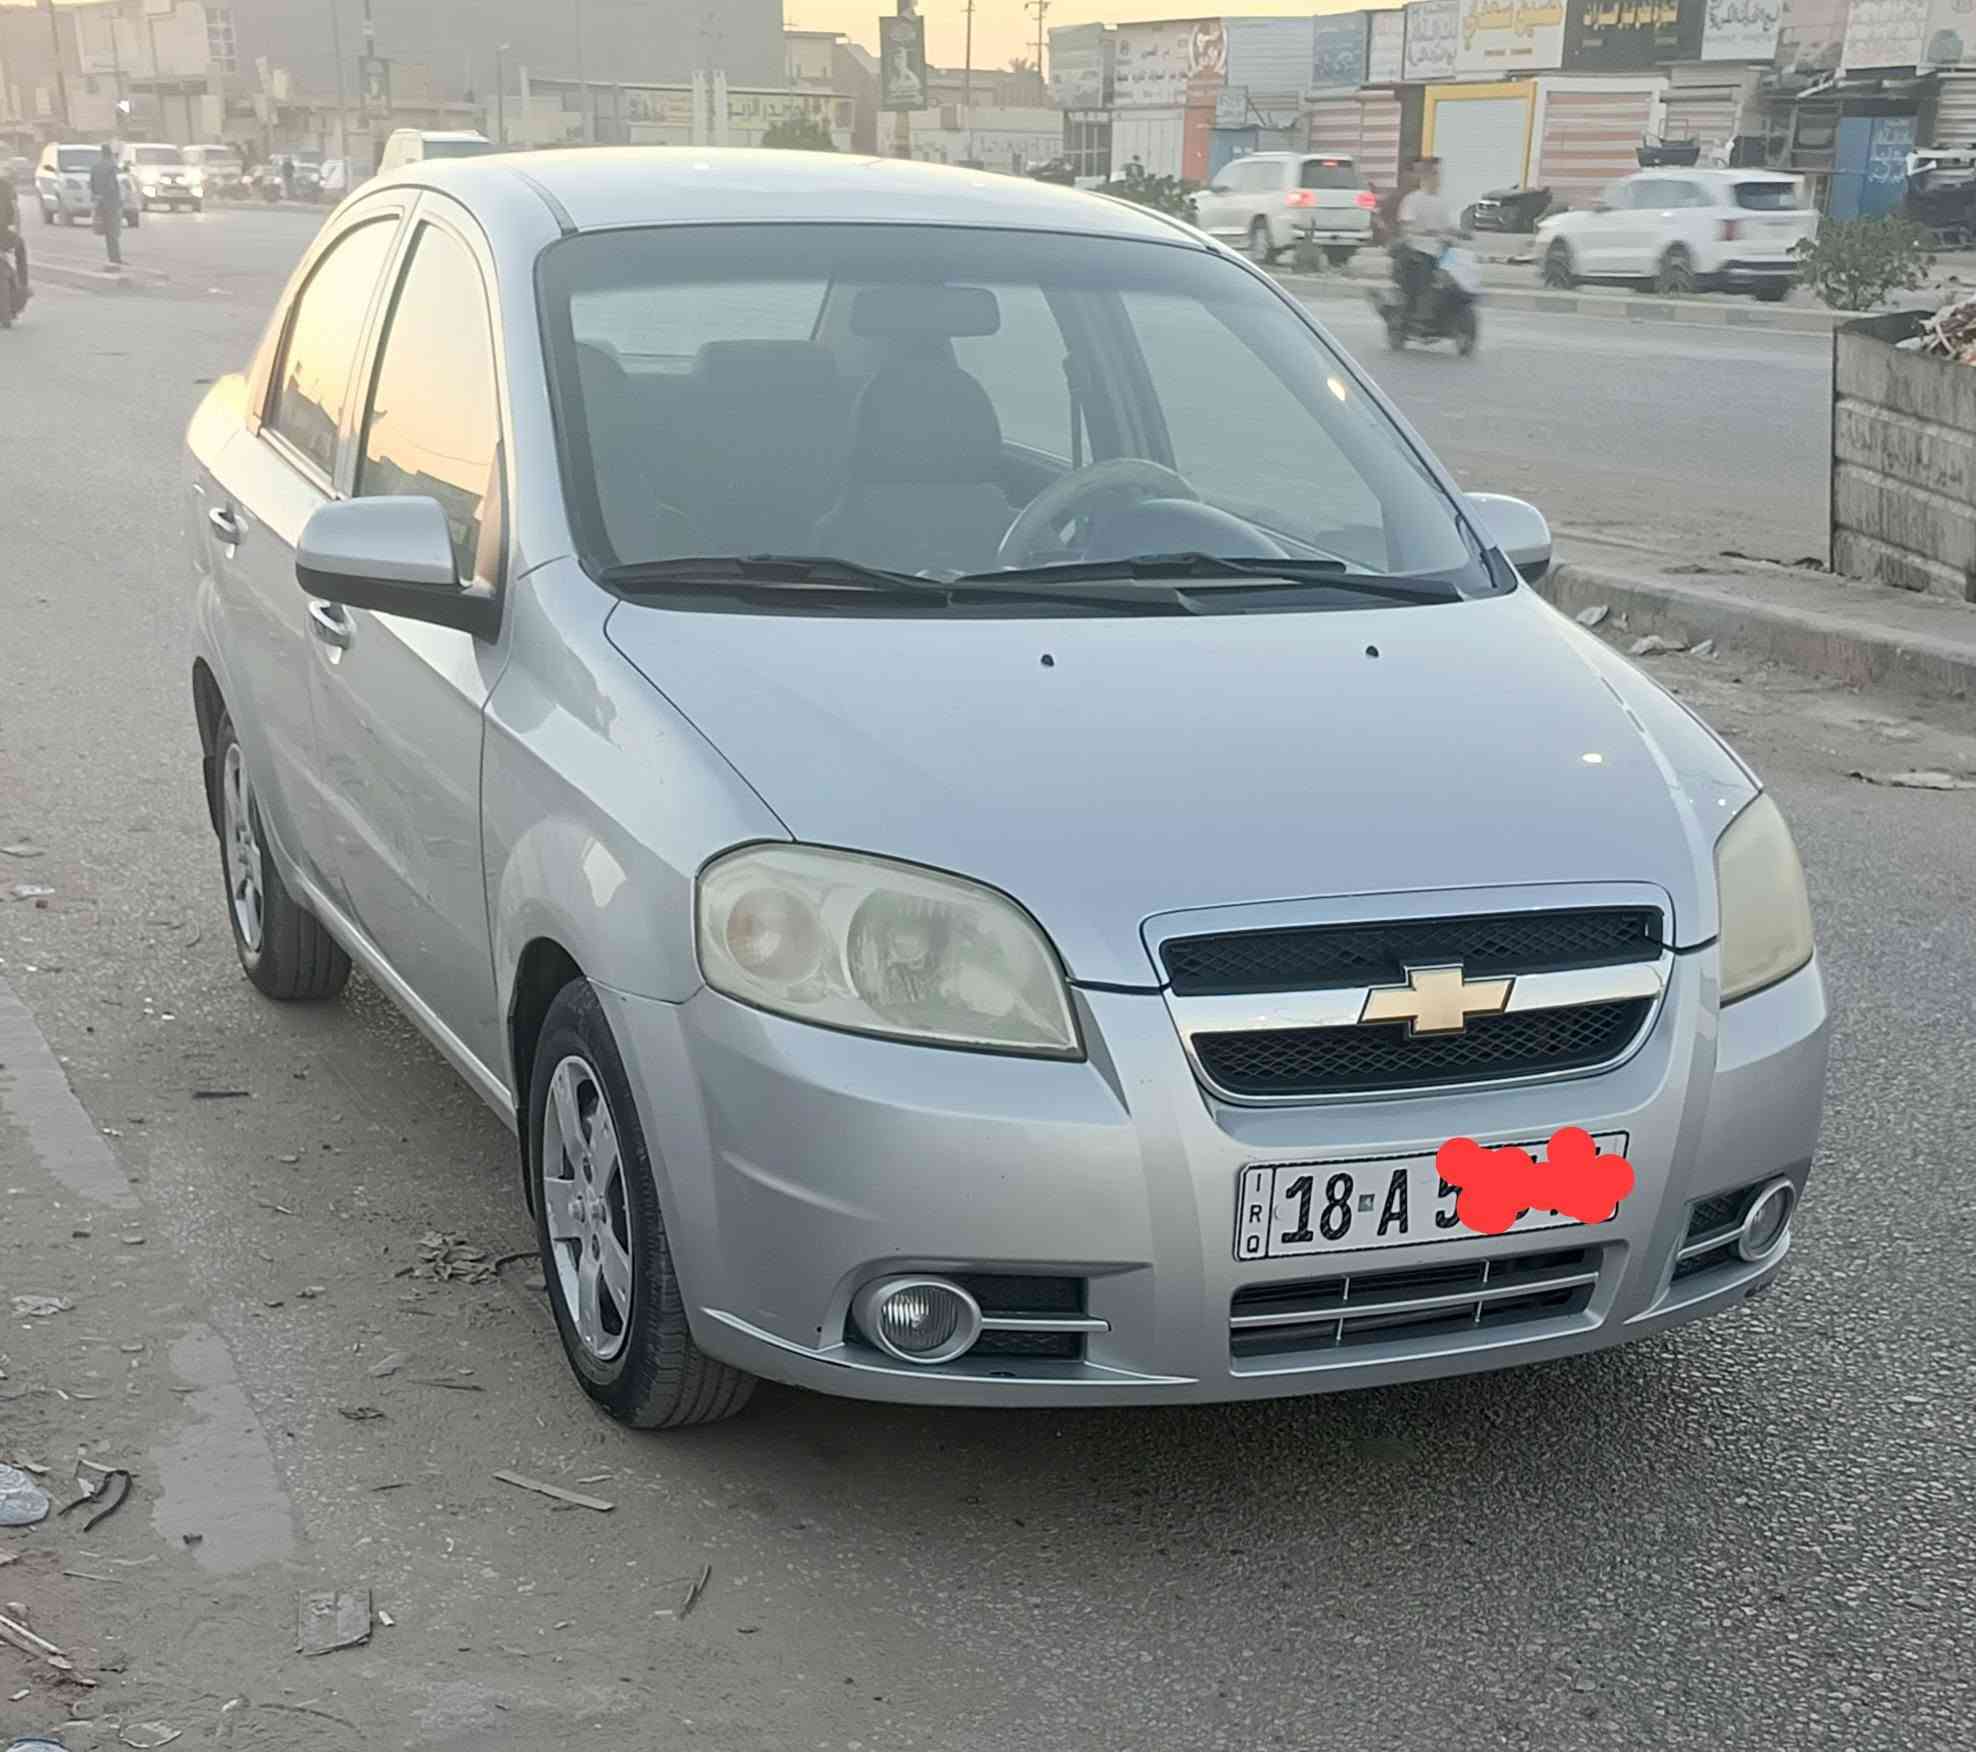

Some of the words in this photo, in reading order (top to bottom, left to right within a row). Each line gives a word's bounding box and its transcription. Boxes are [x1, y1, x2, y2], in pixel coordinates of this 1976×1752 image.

[1246, 1172, 1263, 1253] IRQ
[1280, 1172, 1354, 1244] 18
[1376, 1168, 1409, 1236] A
